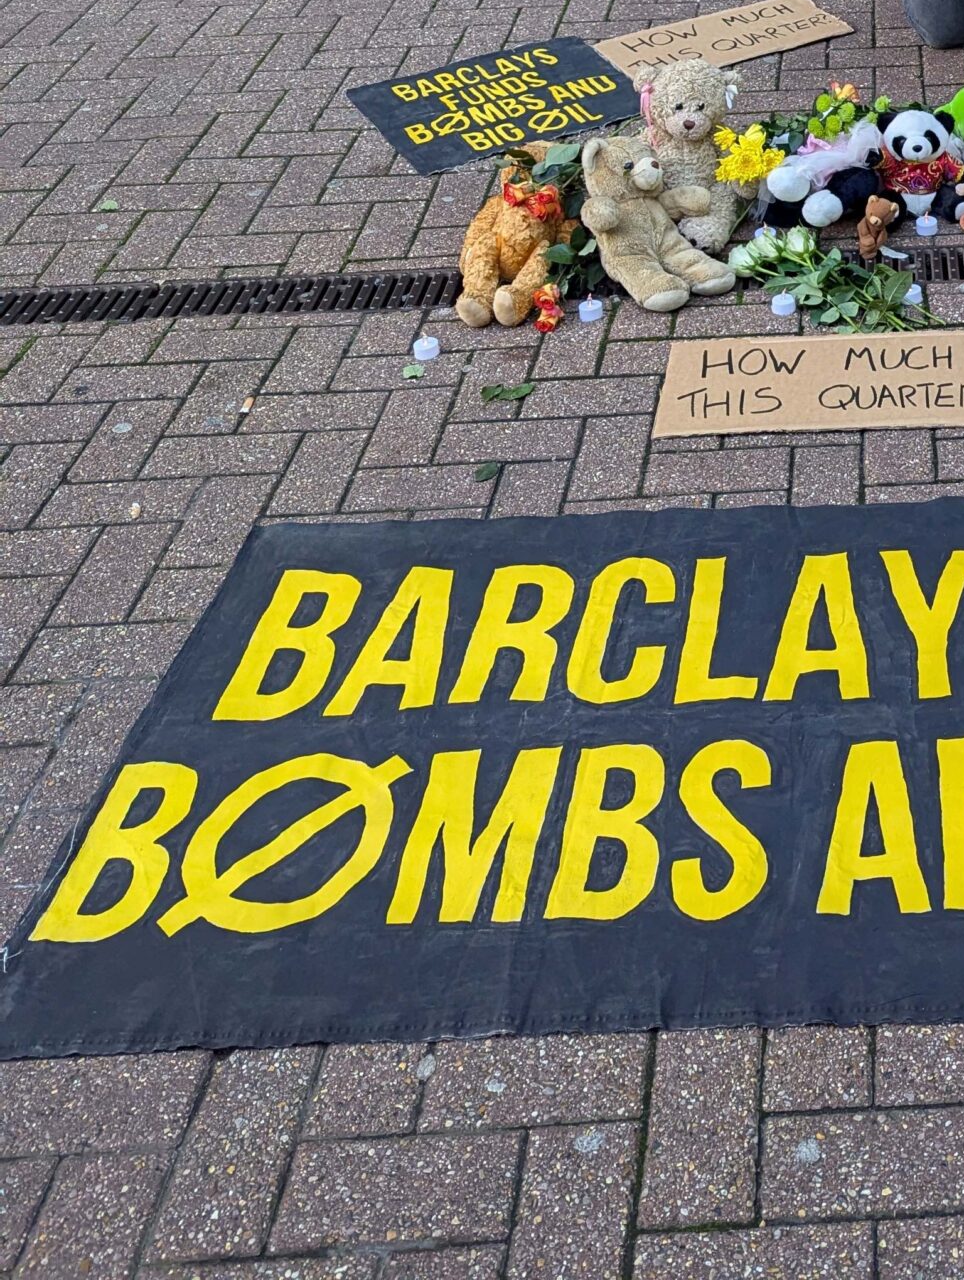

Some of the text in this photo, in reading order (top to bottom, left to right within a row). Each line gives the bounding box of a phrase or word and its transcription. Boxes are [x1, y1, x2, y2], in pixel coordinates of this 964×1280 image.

[621, 3, 794, 53] HOW MUCH
[711, 13, 833, 52] QUARTER?
[391, 48, 559, 102] BARCLAYS
[439, 71, 548, 111] FUNDS
[548, 74, 617, 104] AND
[461, 122, 525, 151] BIG
[701, 345, 953, 379] HOW MUCH
[677, 386, 783, 420] THIS
